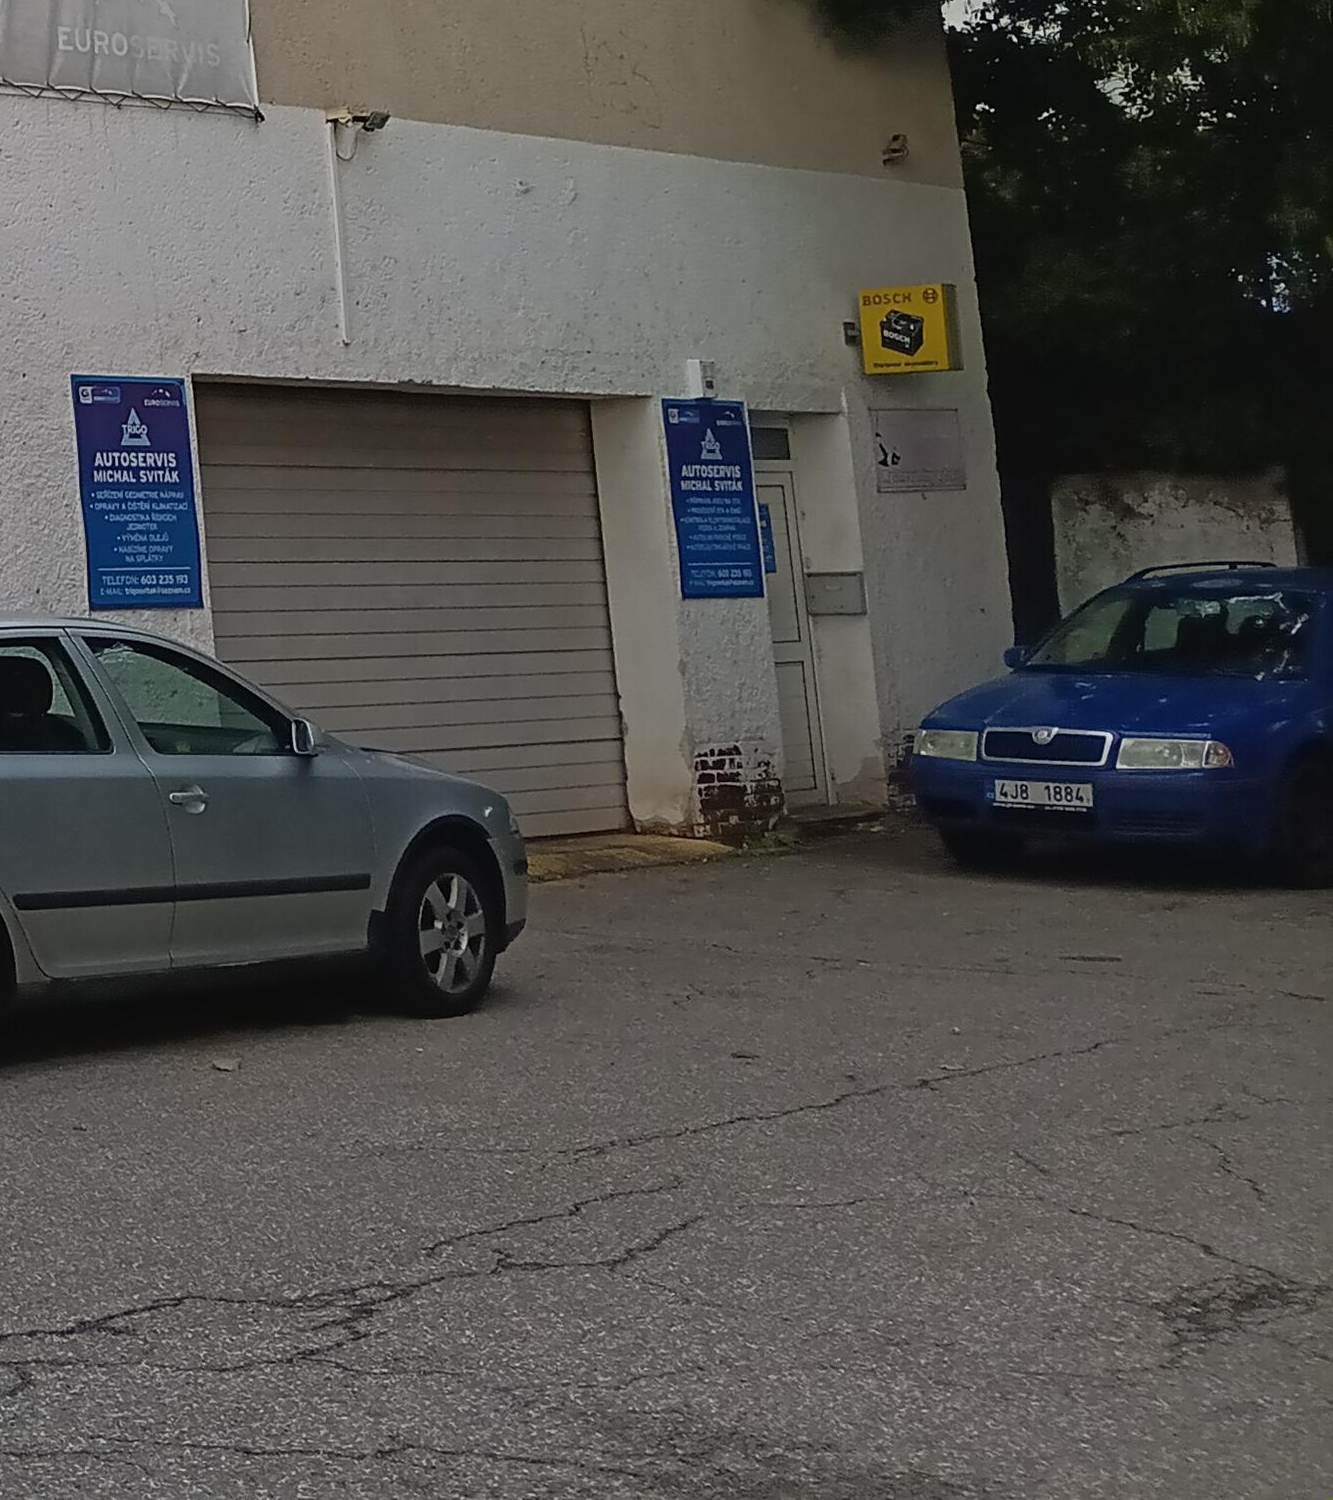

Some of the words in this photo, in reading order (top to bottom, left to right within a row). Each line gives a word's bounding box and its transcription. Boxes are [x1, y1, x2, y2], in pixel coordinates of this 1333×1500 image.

[57, 26, 221, 67] EUROSERVIS
[862, 292, 912, 306] BOSCH
[883, 330, 911, 343] BOSCH
[94, 452, 177, 467] AUTOSERVIS
[93, 470, 136, 483] MICHAL
[139, 468, 180, 483] SVITÁK
[681, 464, 741, 477] AUTOSERVIS
[999, 782, 1029, 800] 4J8
[1044, 784, 1084, 803] 1884
